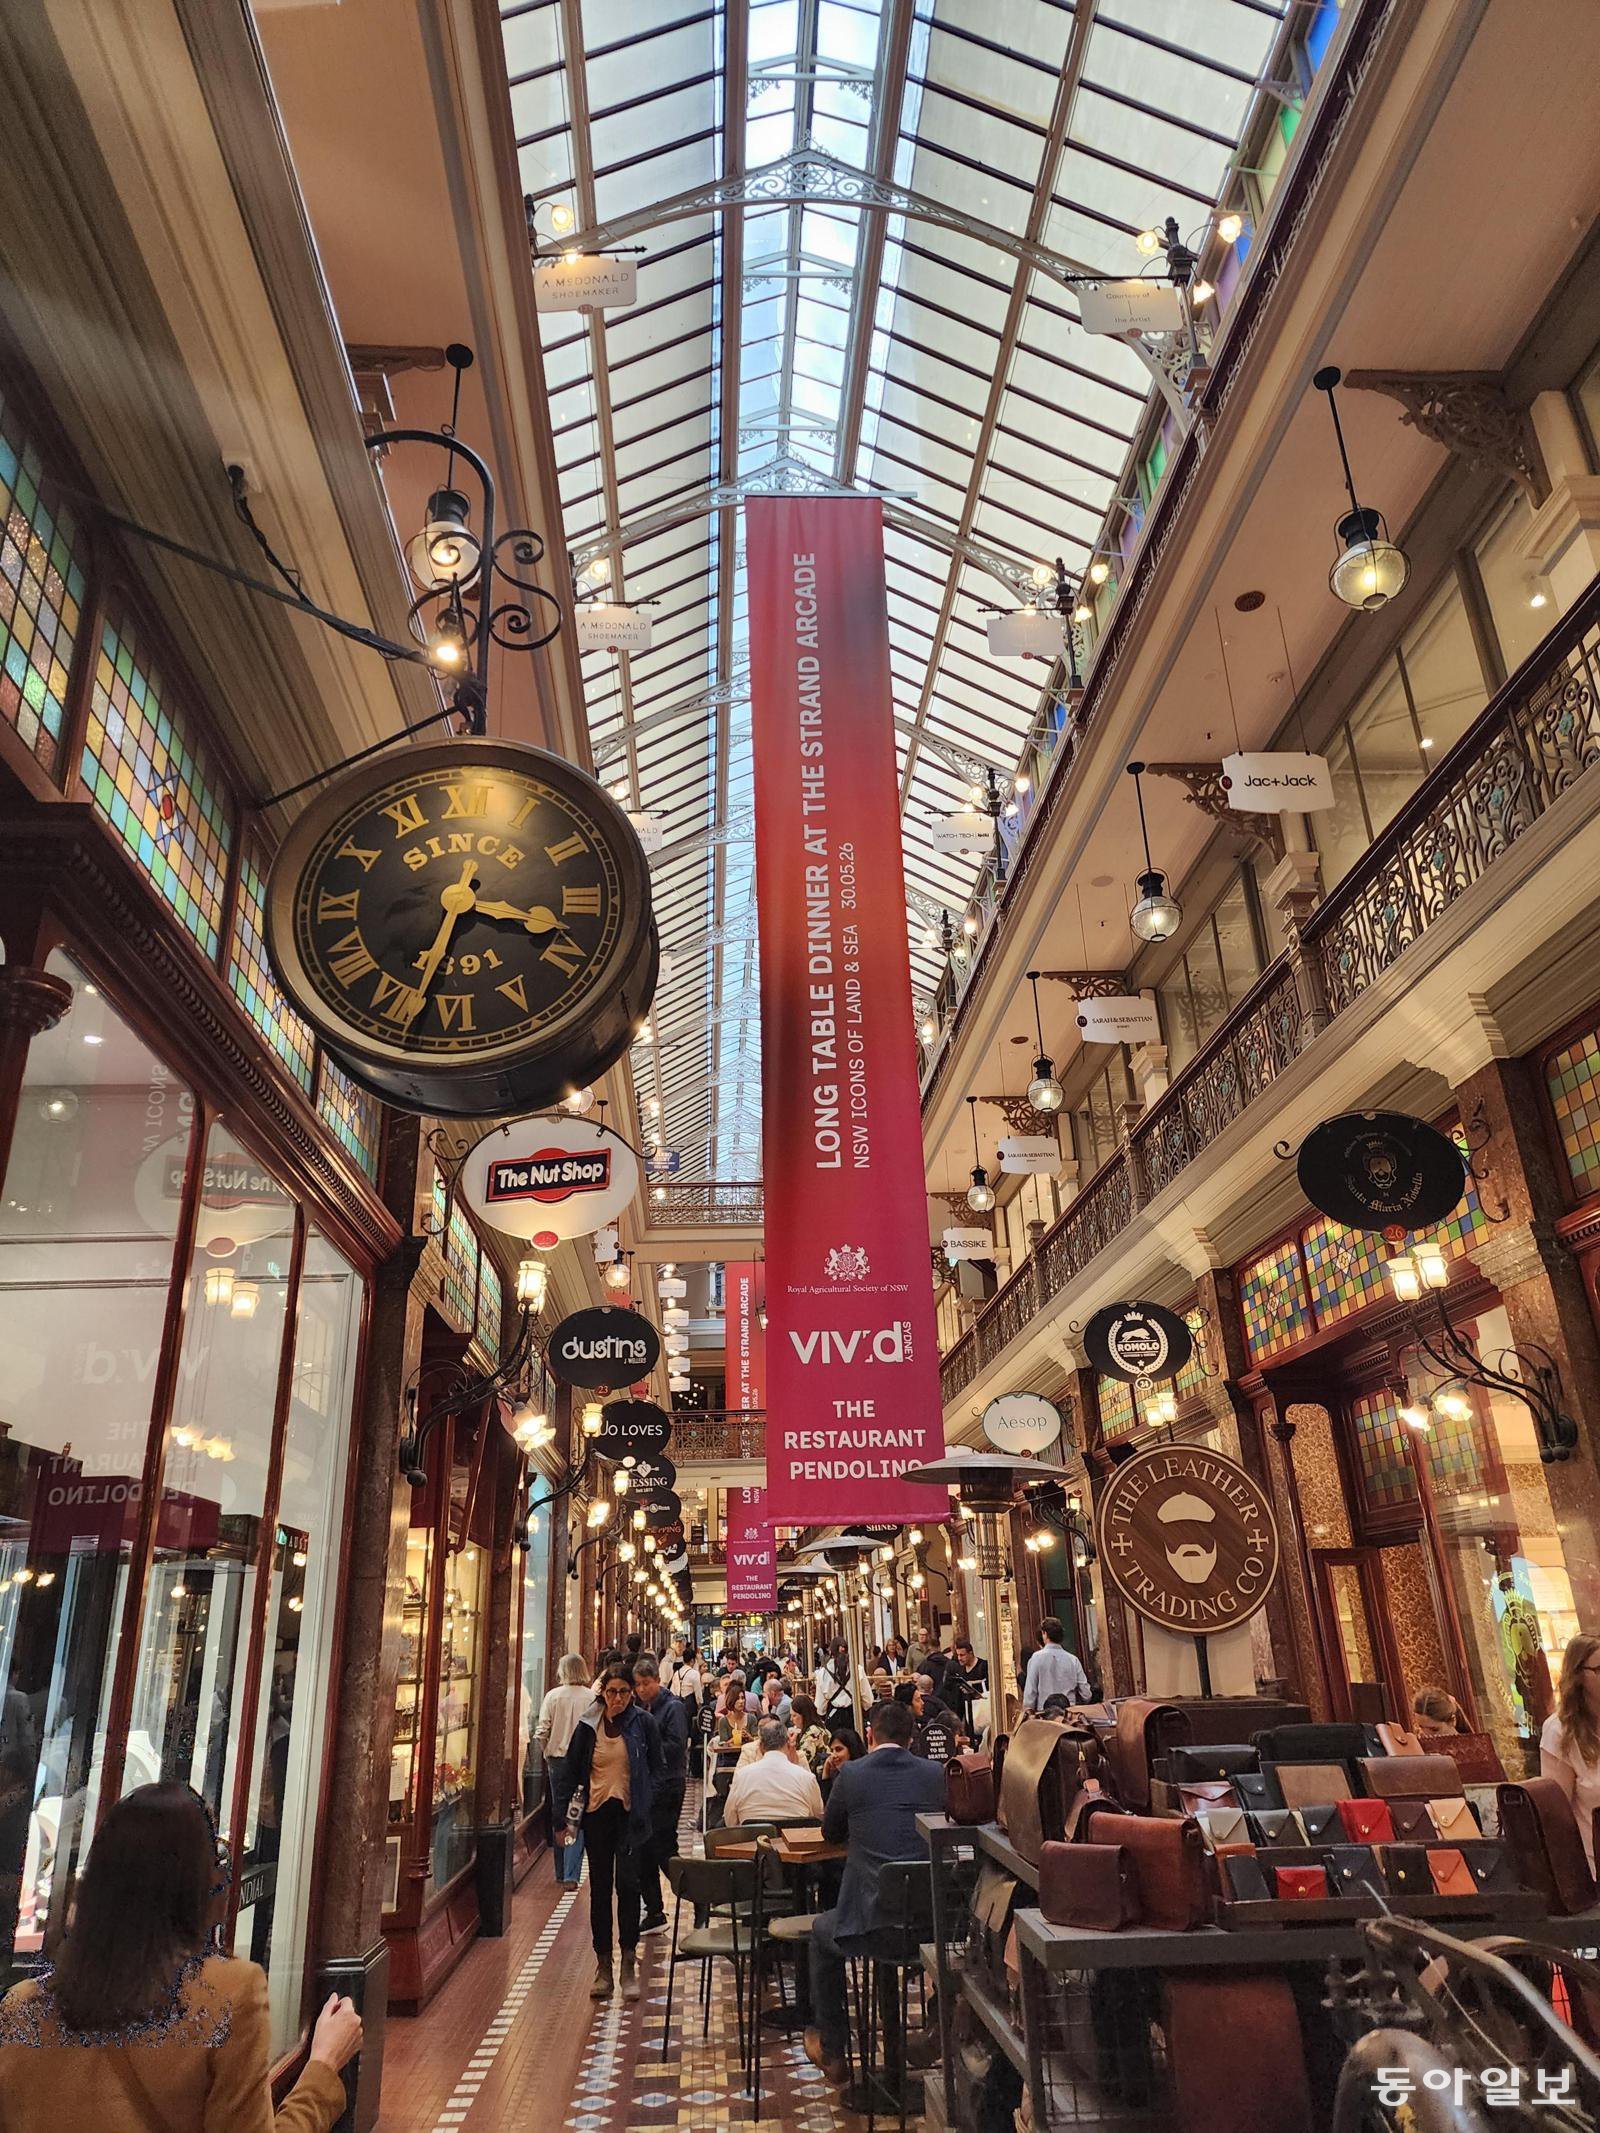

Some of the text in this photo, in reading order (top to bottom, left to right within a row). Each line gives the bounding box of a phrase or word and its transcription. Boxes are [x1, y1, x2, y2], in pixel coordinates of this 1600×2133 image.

[542, 280, 550, 288] A
[552, 288, 618, 299] SHOEMAKER
[1244, 774, 1317, 786] Jac+Jack
[402, 832, 526, 871] SINCE
[794, 553, 841, 1168] LONG TABLE DINNER AT THE STRAND ARCADE
[839, 842, 870, 1168] NSW ICONS OF LAND & SEA 30.05.26
[498, 1161, 604, 1189] The Nut Shop
[1388, 1228, 1402, 1239] 26
[950, 1240, 987, 1248] BASSIKE
[740, 1277, 749, 1316] ARCADE
[787, 1284, 908, 1294] Royal Agricultural Society of NSW
[562, 1335, 647, 1360] dustins
[741, 1318, 749, 1357] STRAND
[903, 1321, 914, 1362] SYDNEY
[1117, 1342, 1160, 1351] ROMOLO
[741, 1359, 749, 1379] THE
[742, 1381, 749, 1393] AT
[832, 1400, 875, 1418] THE
[600, 1420, 663, 1436] JO LOVES
[998, 1416, 1047, 1430] Aesop
[784, 1429, 926, 1449] RESTAURANT
[1111, 1457, 1259, 1526] THE LEATHER
[1122, 1556, 1264, 1620] TRADING CO
[238, 1876, 264, 1911] NDIAL
